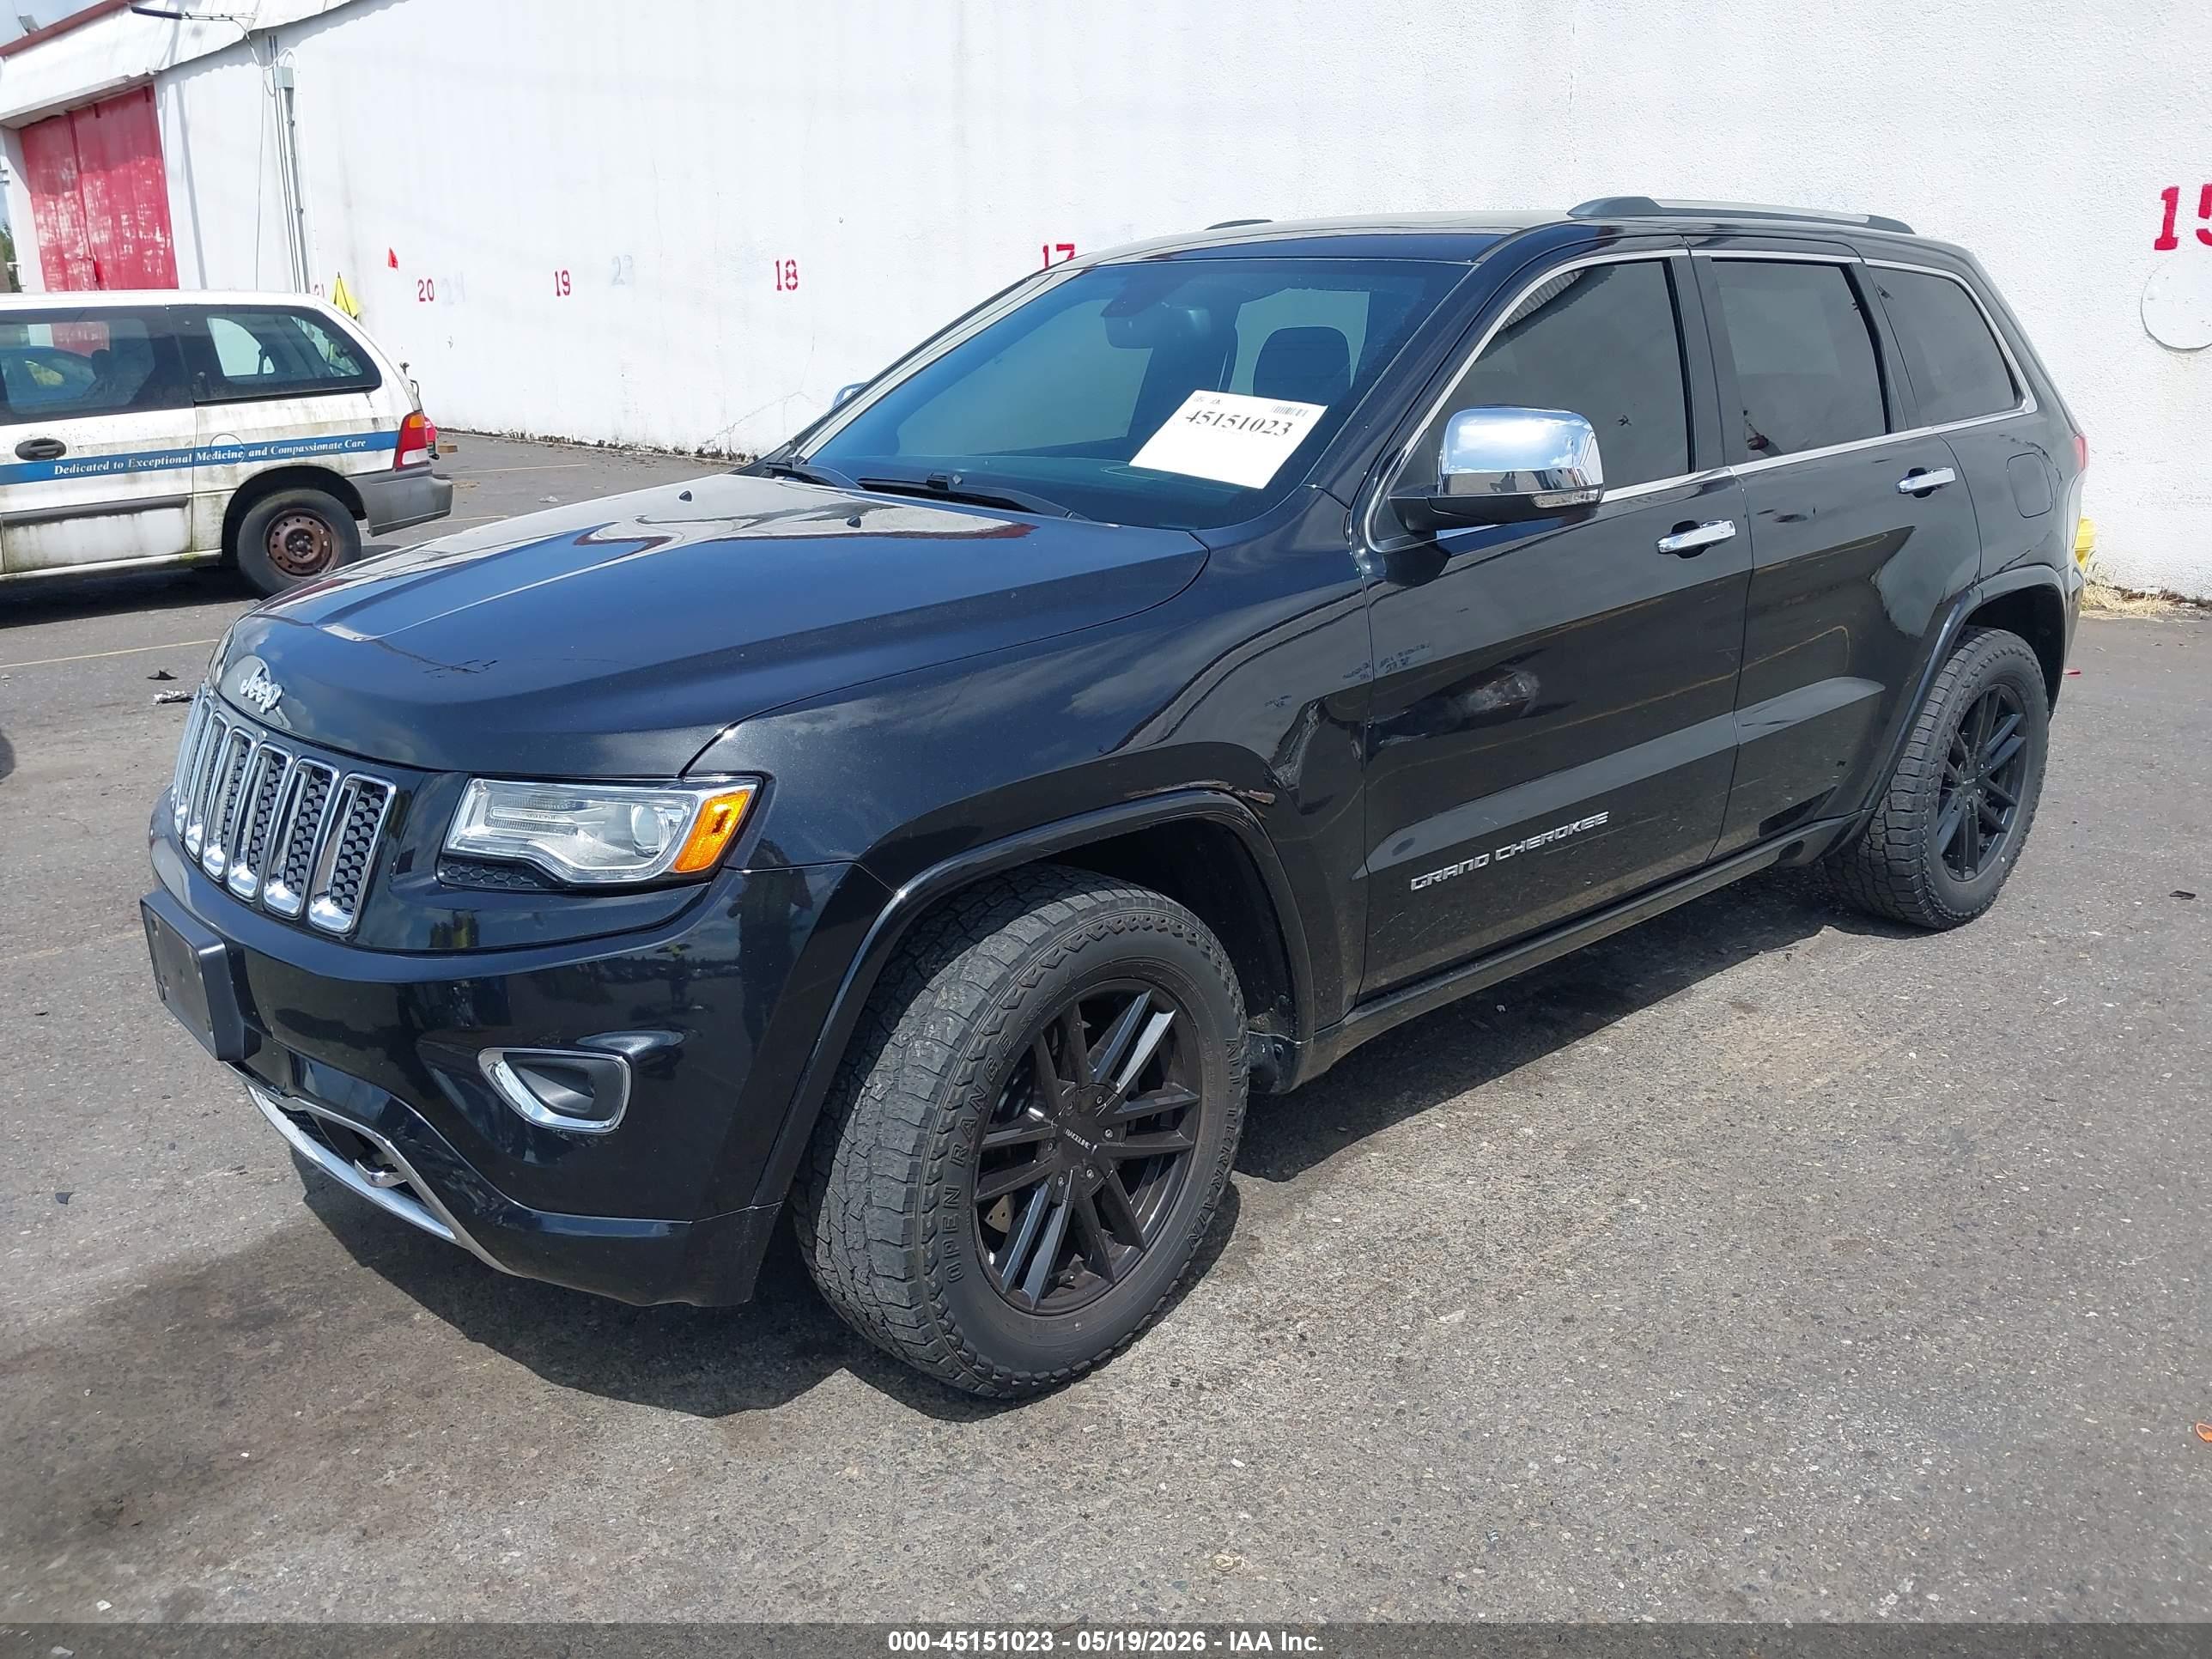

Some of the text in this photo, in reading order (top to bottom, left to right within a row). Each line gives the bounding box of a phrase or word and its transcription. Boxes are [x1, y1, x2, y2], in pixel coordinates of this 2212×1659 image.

[417, 277, 435, 302] 20
[554, 270, 571, 297] 19
[775, 258, 799, 291] 18
[1185, 410, 1294, 437] 45151023
[54, 438, 367, 477] Dedicated to Exceptional Medicine and Compassionate Care
[240, 665, 284, 715] Jeep
[1410, 811, 1610, 891] GRAND CHEROKEE
[942, 1030, 1014, 1285] OPEN RANGE
[1186, 1106, 1238, 1253] TERRAIN
